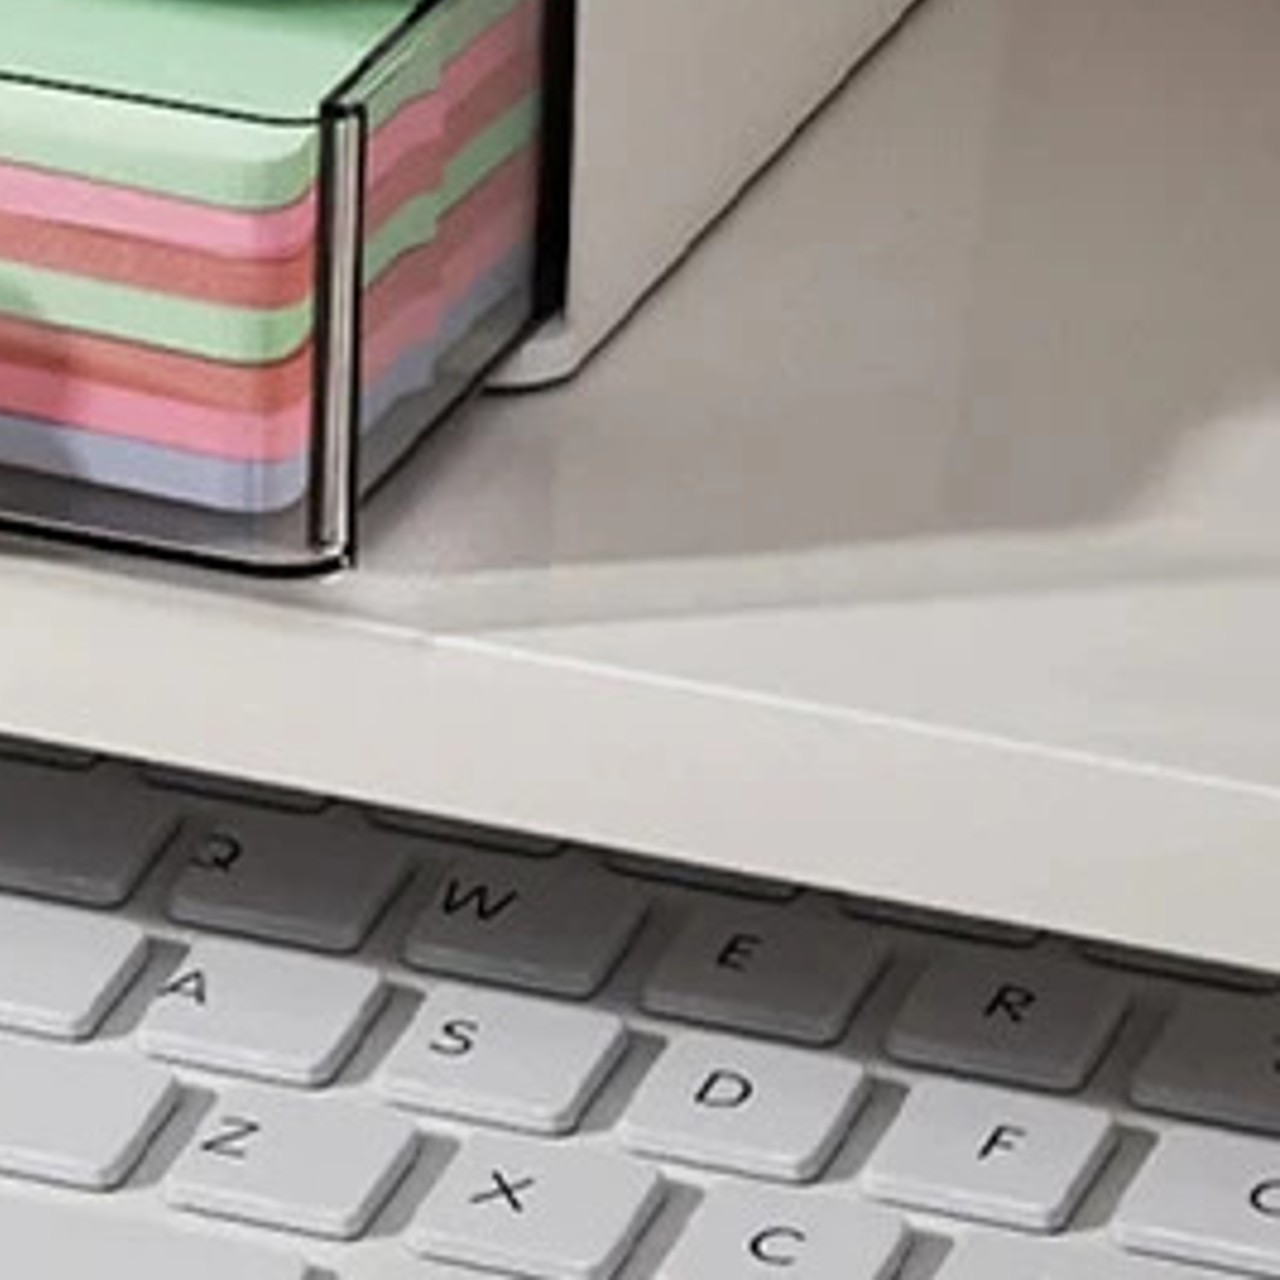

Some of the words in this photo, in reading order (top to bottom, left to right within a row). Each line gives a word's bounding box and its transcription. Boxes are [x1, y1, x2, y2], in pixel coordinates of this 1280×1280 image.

[188, 832, 243, 873] Q
[442, 879, 518, 921] W
[715, 933, 763, 972] E
[158, 969, 207, 1005] A
[983, 983, 1037, 1023] R
[428, 1019, 480, 1057] S
[693, 1070, 754, 1108] D
[200, 1116, 261, 1159] Z
[977, 1124, 1027, 1160] F
[469, 1169, 535, 1213] X
[748, 1225, 807, 1267] C
